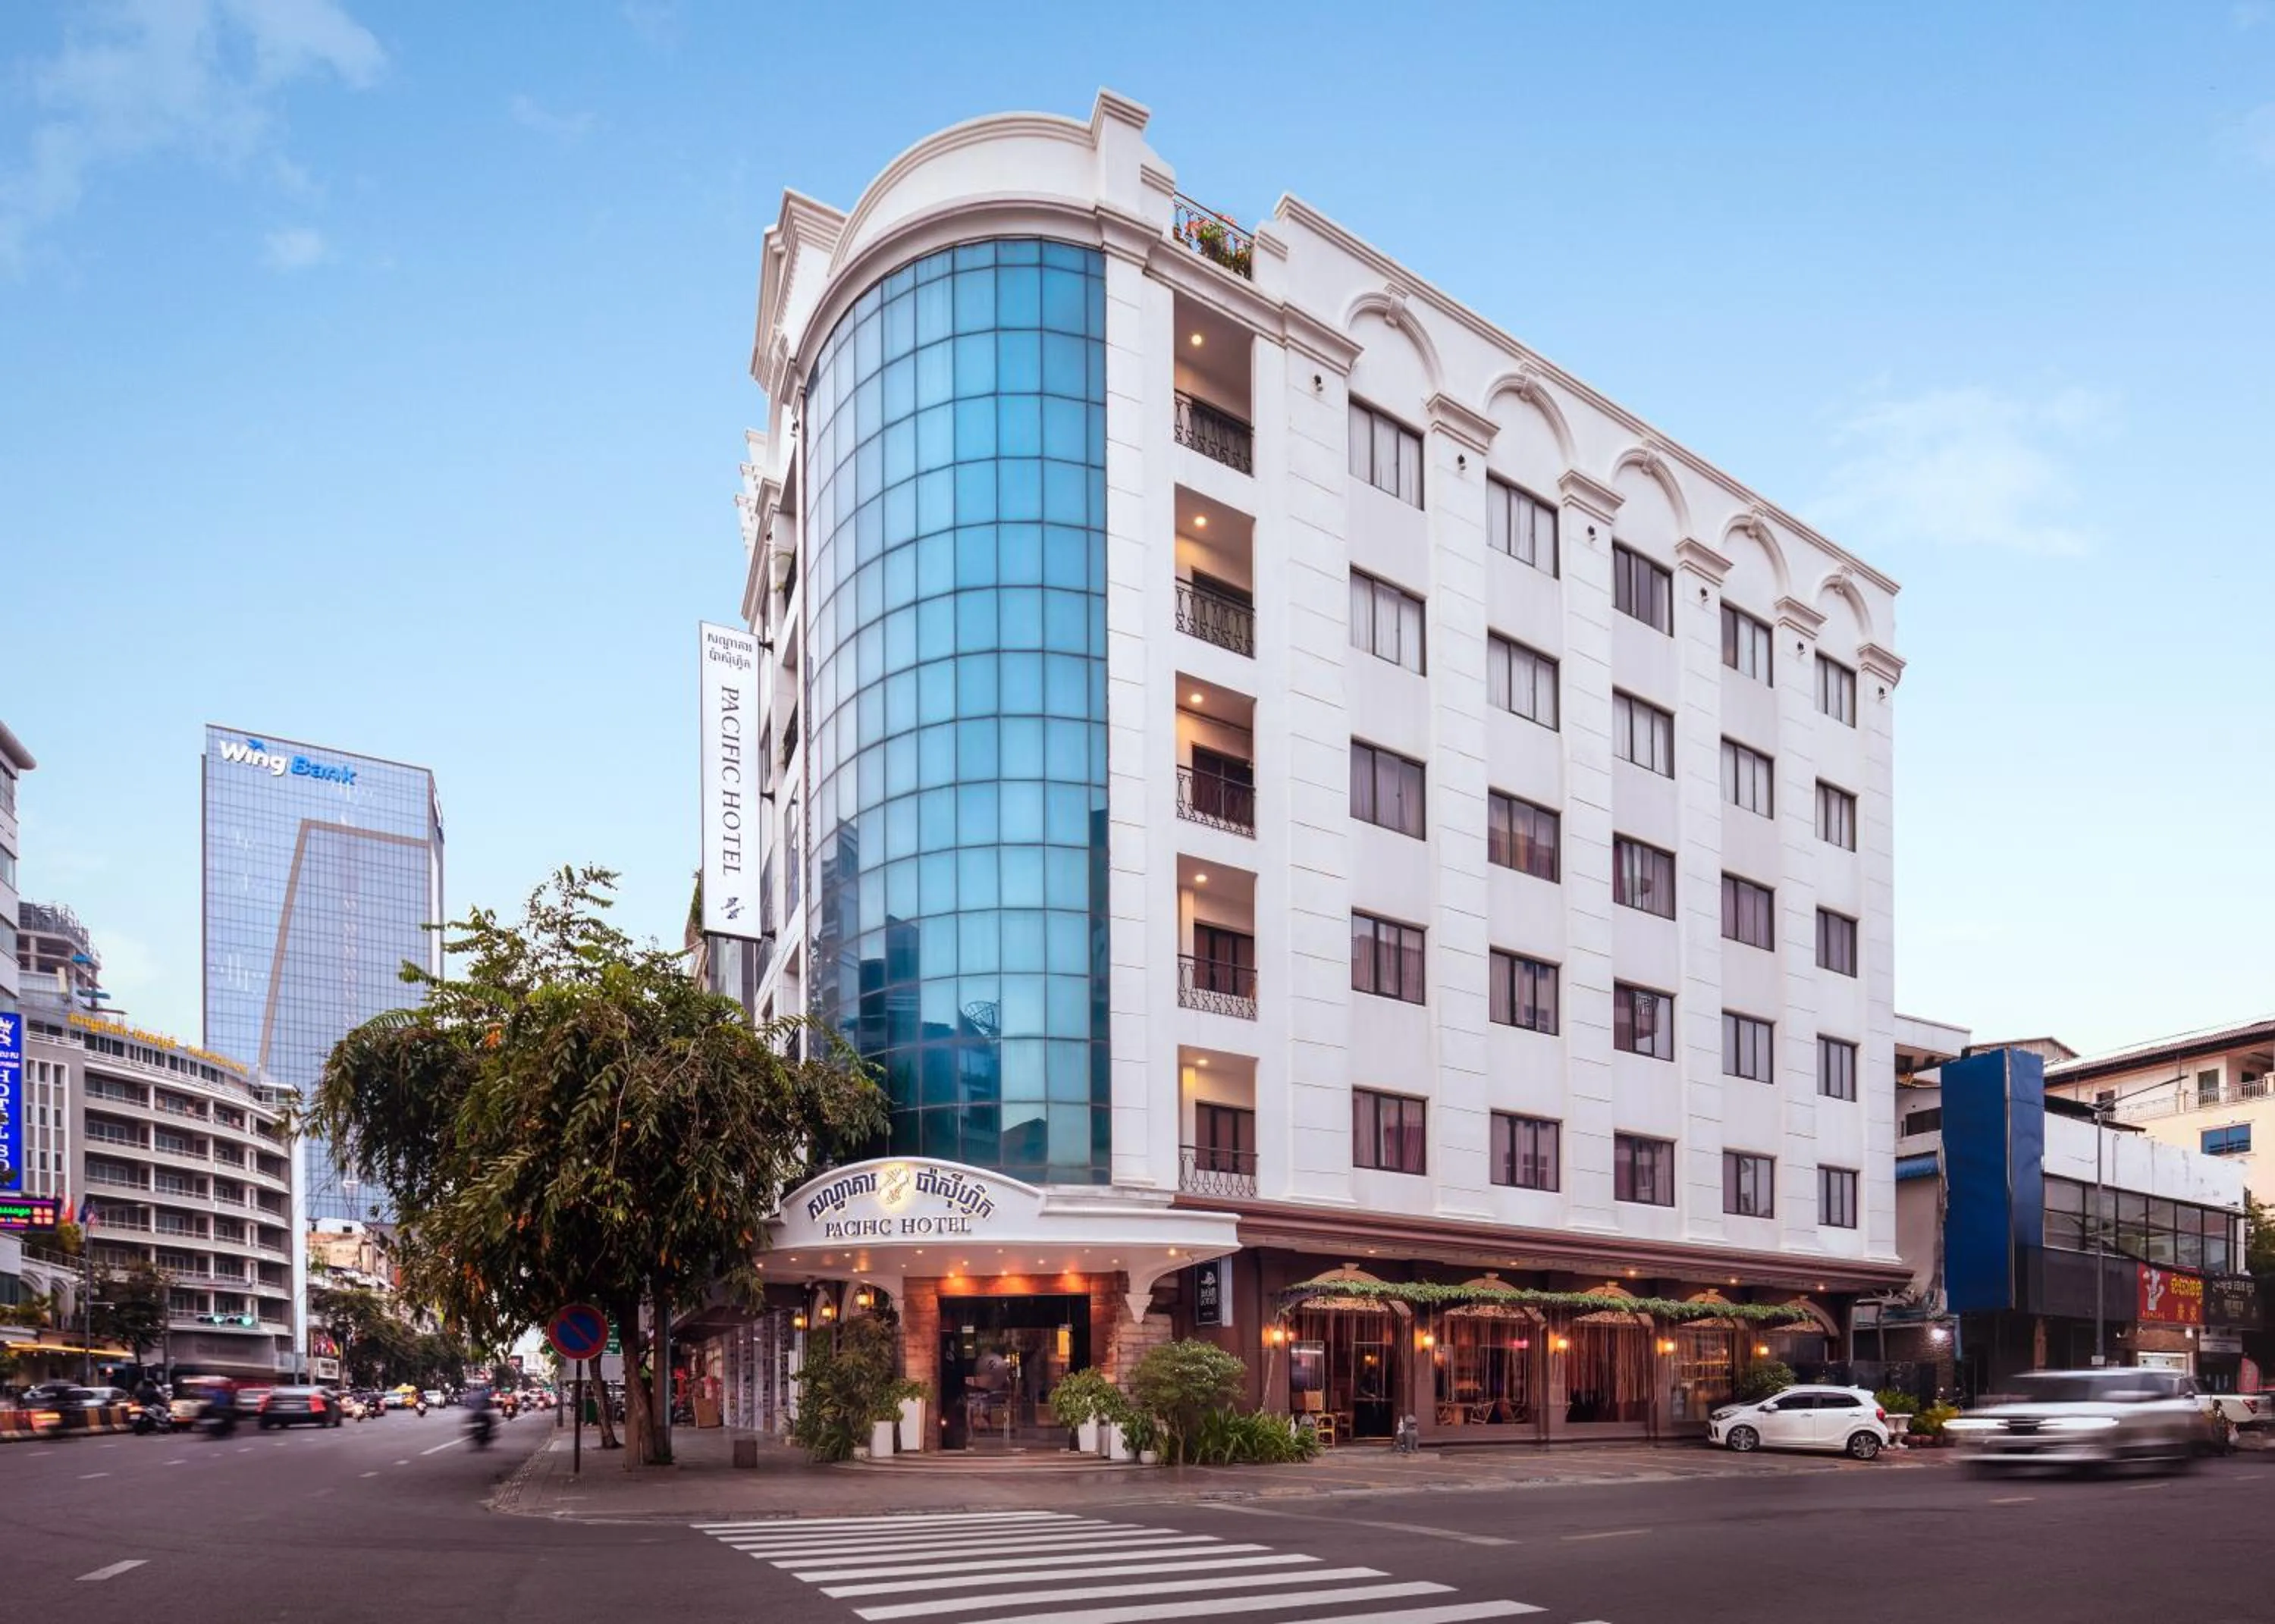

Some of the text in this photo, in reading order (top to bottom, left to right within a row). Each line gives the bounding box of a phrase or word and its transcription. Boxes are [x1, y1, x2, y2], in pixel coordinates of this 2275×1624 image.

[219, 740, 357, 785] Wing Bank
[722, 686, 741, 875] PACIFIC HOTEL
[825, 1217, 971, 1238] PACIFIC HOTEL
